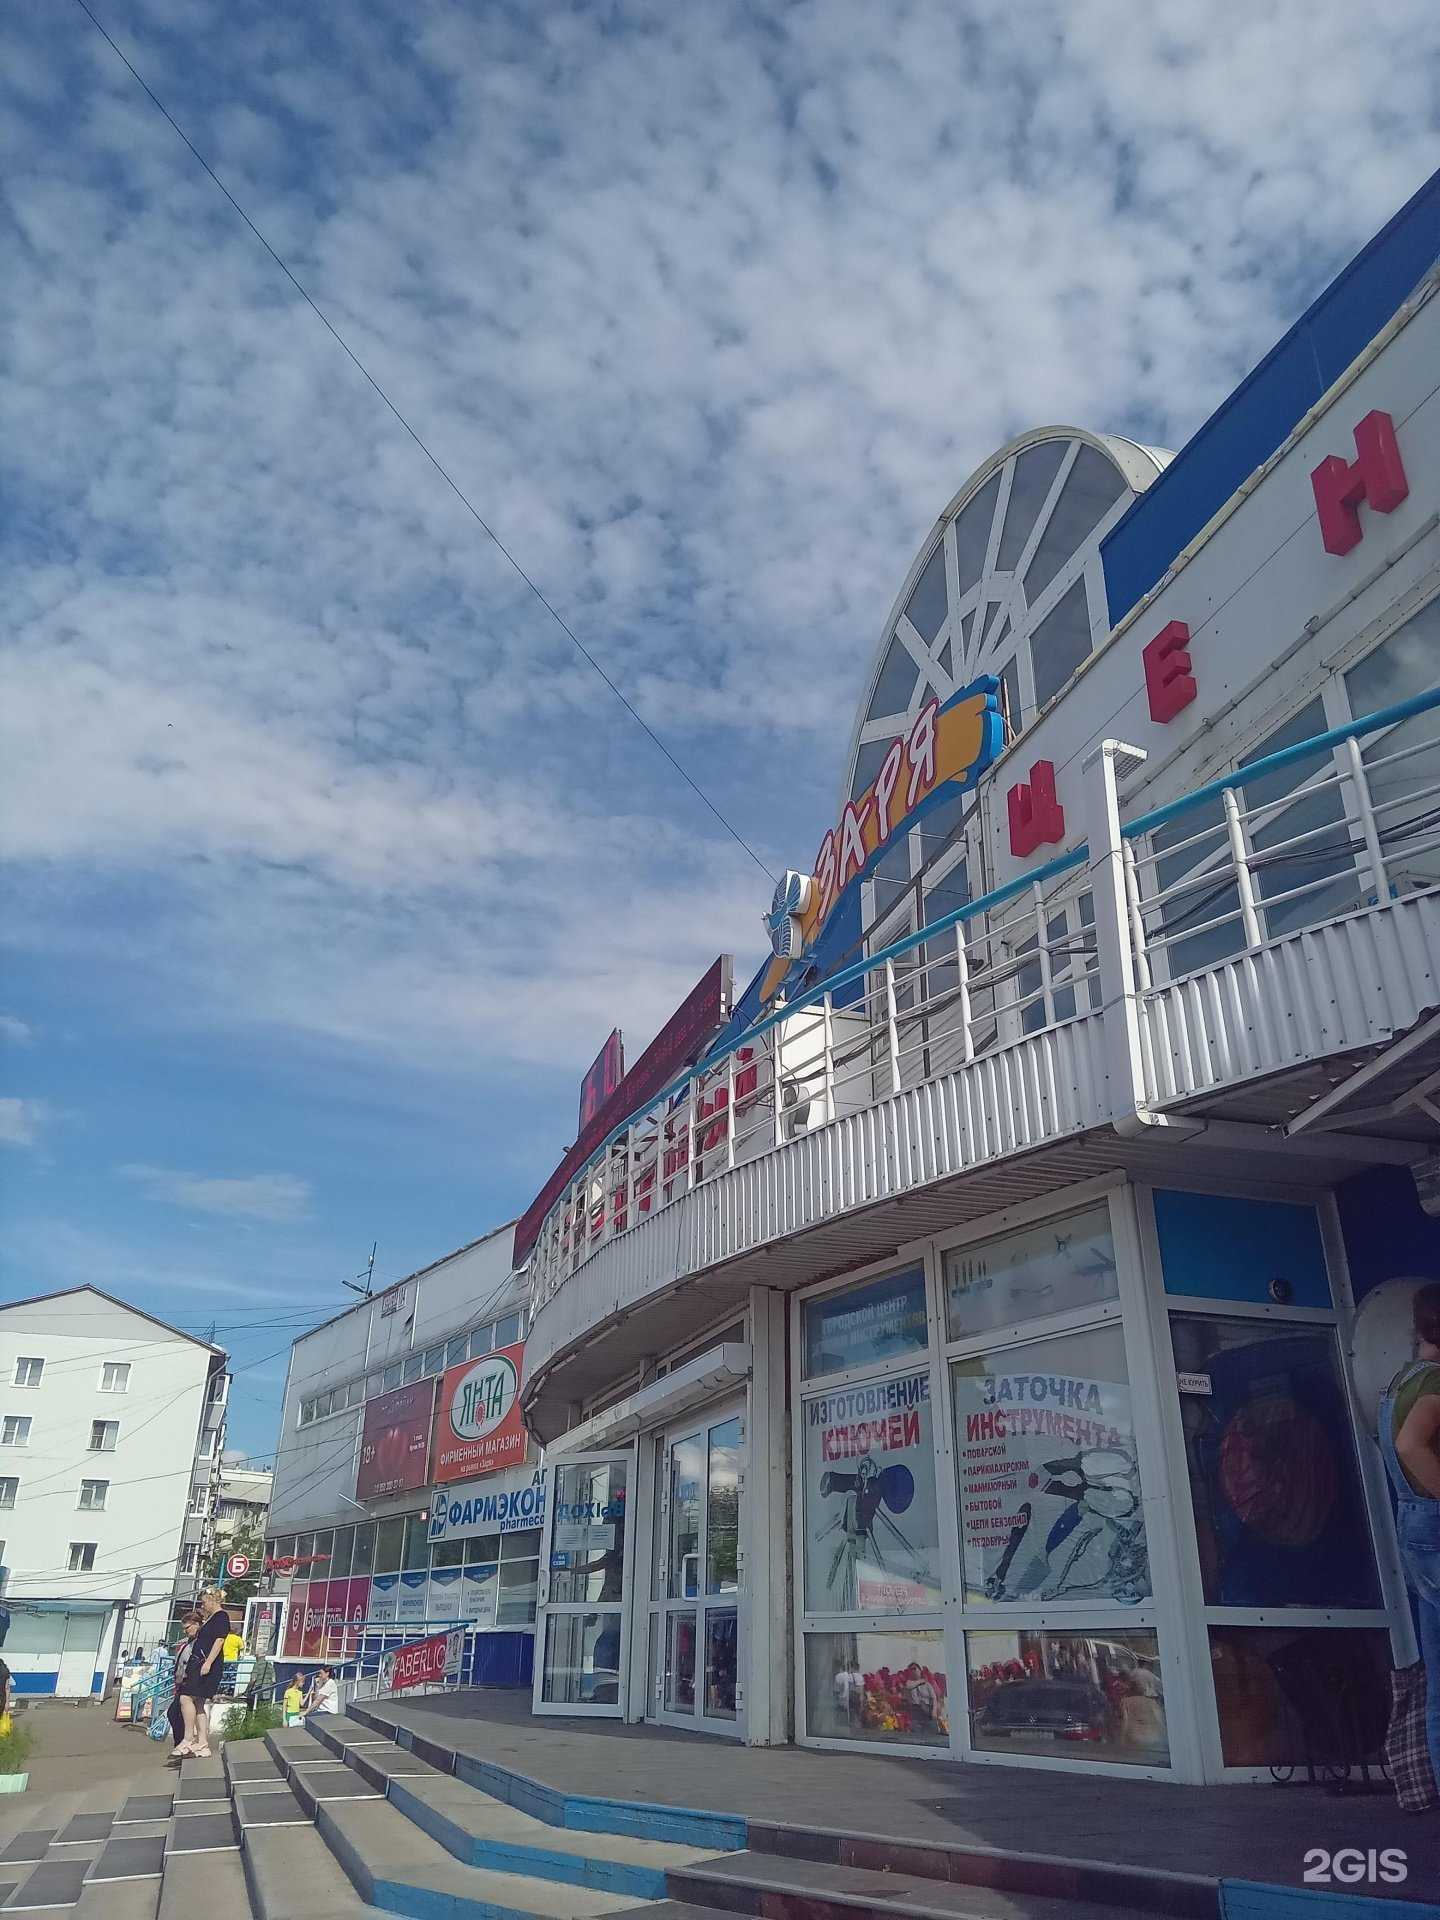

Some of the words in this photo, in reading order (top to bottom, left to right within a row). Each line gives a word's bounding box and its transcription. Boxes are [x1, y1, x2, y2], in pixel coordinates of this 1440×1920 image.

[815, 697, 939, 926] ЗАРЯ
[460, 1369, 506, 1427] ЯНТА
[809, 1375, 930, 1427] ИЗГОТОВЛЕНИЕ
[983, 1376, 1104, 1415] ЗАТОЧКА
[822, 1404, 920, 1462] КЛЮЧЕЙ
[966, 1408, 1121, 1448] ИНСТРУМЕНТА
[363, 1445, 376, 1465] 18+
[440, 1440, 483, 1466] ФИРМЕННЫЙ
[485, 1433, 521, 1456] МАГАЗИН
[967, 1444, 1006, 1459] ПОВАРСКОЙ
[449, 1486, 546, 1526] ФАРМЭКОН
[969, 1500, 1002, 1512] БЫТОВОЙ
[970, 1517, 989, 1531] ЦЕПИ
[392, 1644, 446, 1678] FABERLIC
